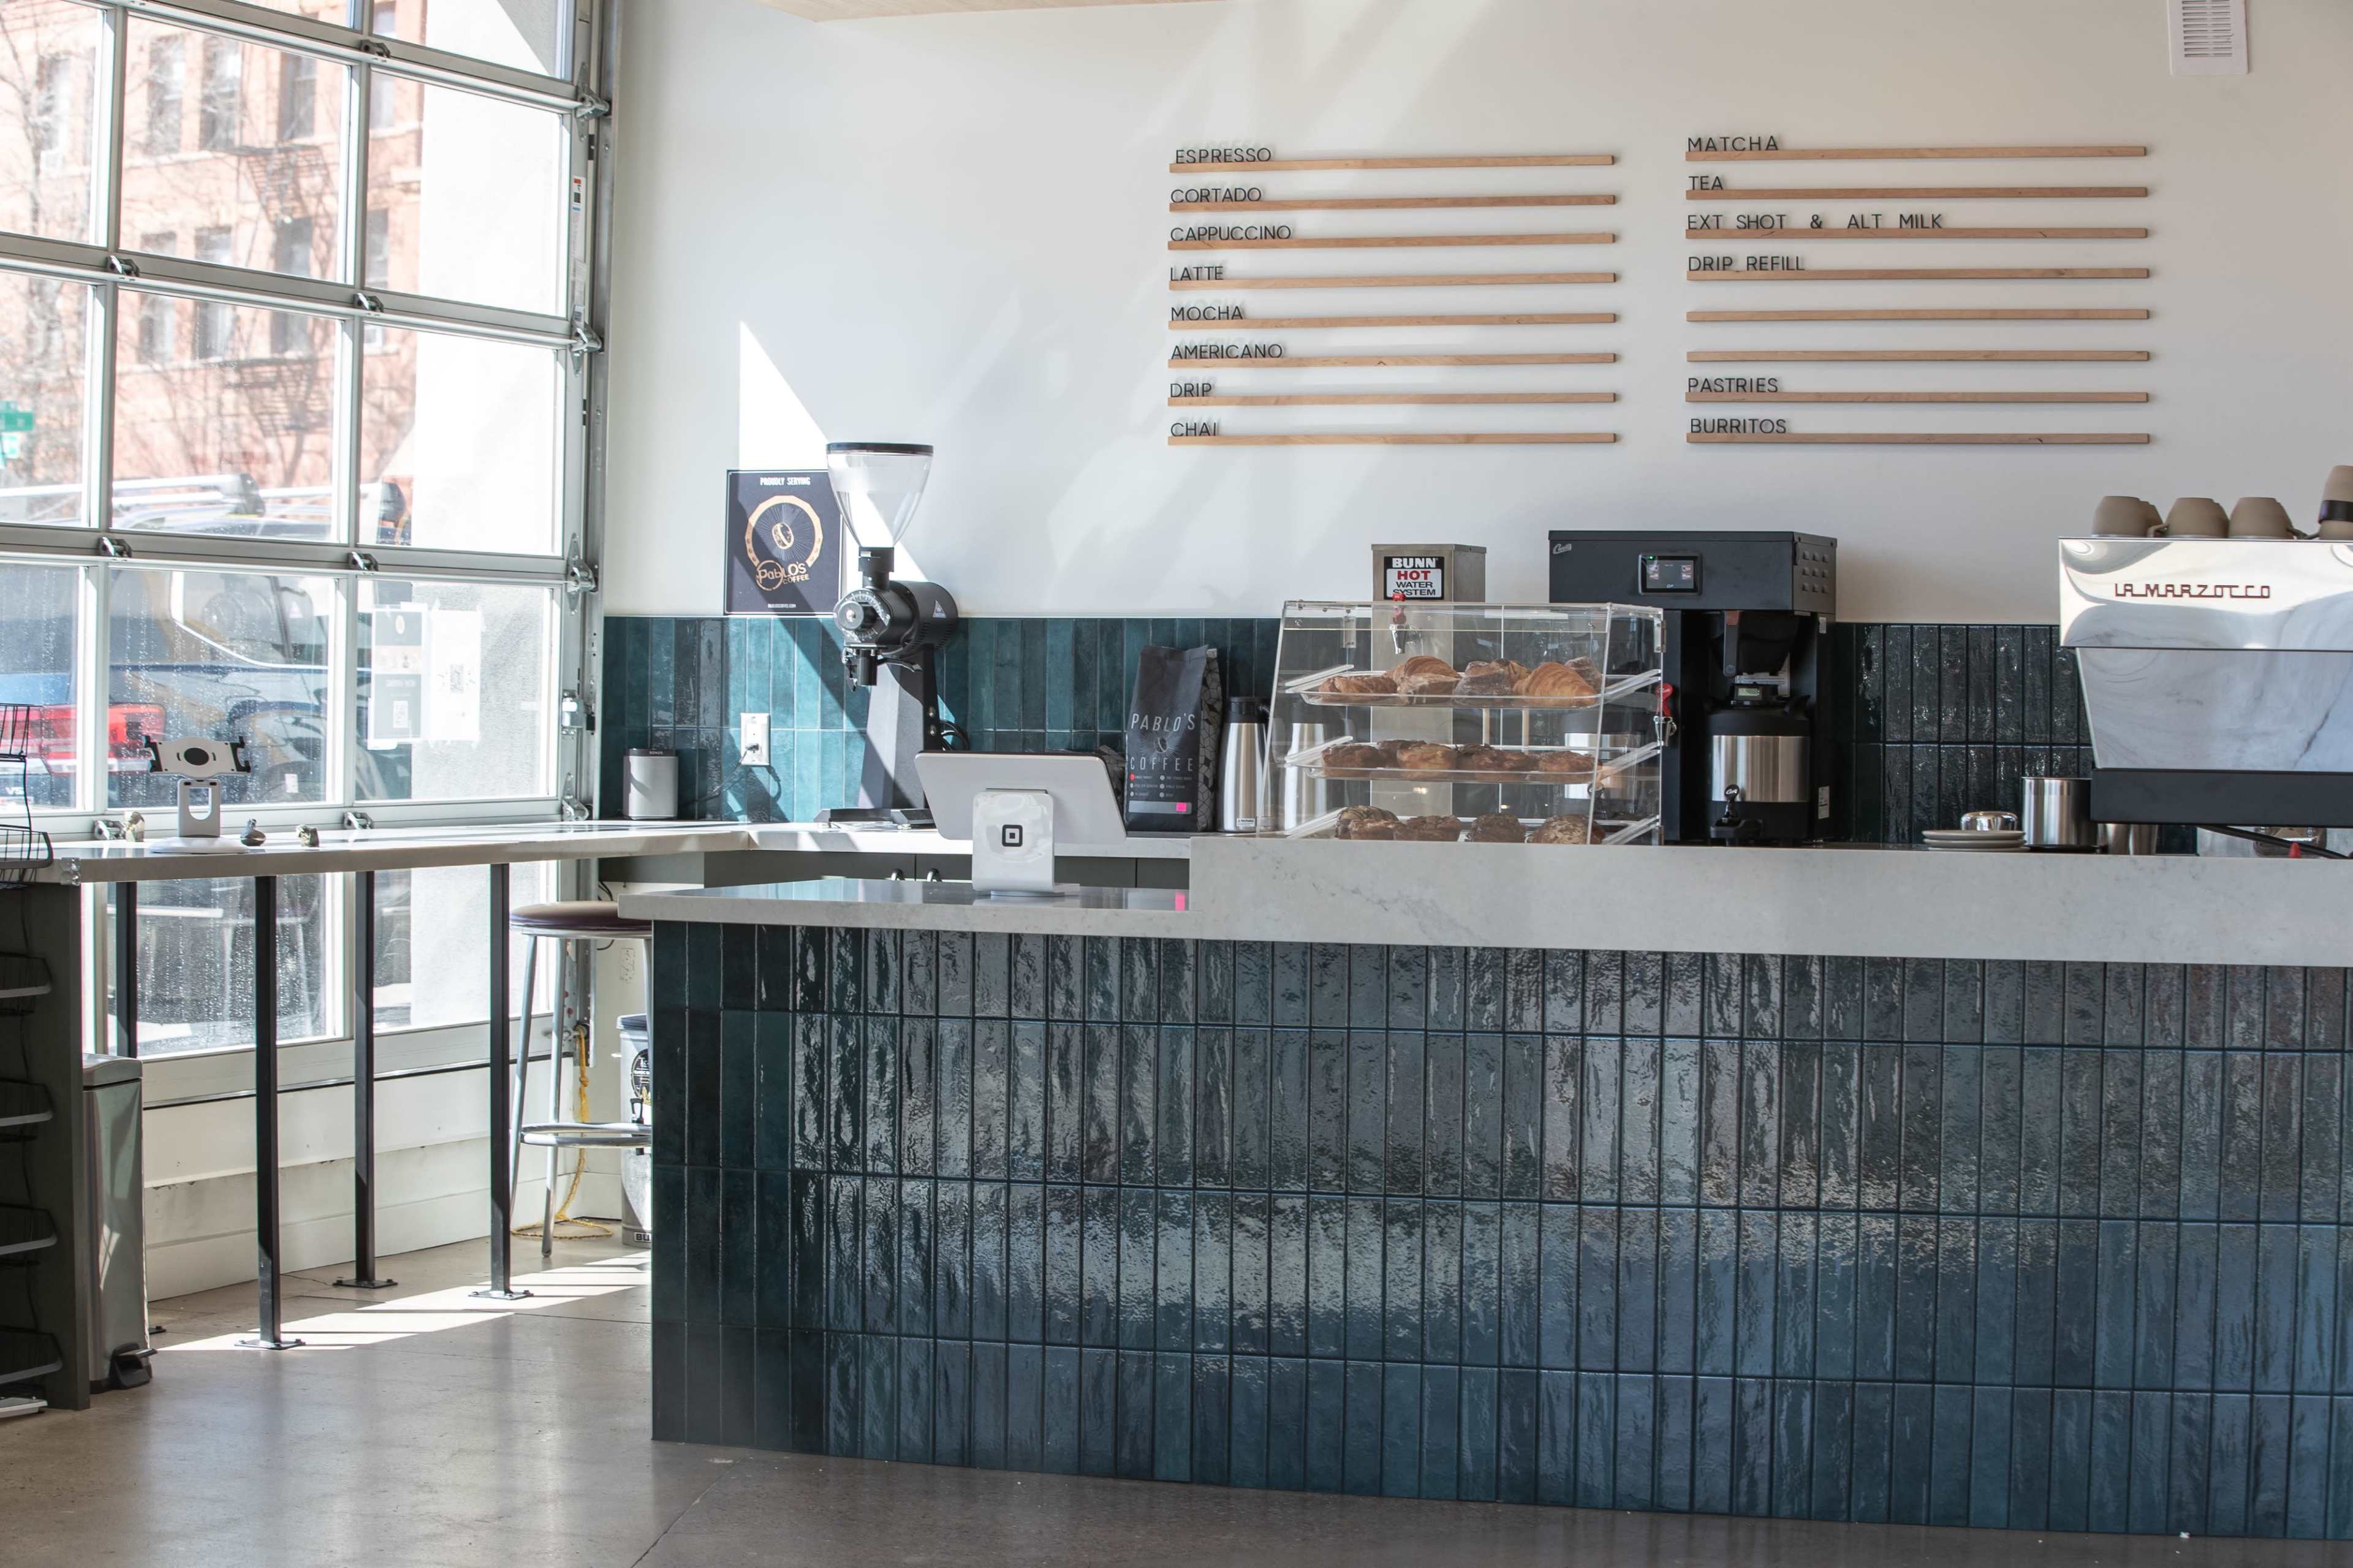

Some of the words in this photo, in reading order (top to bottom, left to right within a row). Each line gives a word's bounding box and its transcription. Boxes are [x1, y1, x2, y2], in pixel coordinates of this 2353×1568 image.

[1688, 135, 1779, 152] MATCHA
[1175, 148, 1271, 164] ESPRESSO
[1689, 176, 1724, 191] TEA
[1170, 187, 1262, 203] CORTADO
[1688, 214, 1723, 230] EXT
[1736, 214, 1787, 230] SHOT
[1809, 214, 1824, 230] &
[1847, 214, 1882, 230] ALT
[1899, 214, 1943, 229] MILK
[1170, 225, 1292, 241] CAPPUCCINO
[1688, 256, 1733, 271] DRIP
[1746, 256, 1805, 271] REFILL
[1170, 266, 1224, 281] LATTE
[1171, 306, 1243, 321] MOCHA
[1170, 343, 1283, 360] AMERICANO
[1170, 383, 1213, 398] DRIP
[1688, 377, 1779, 393] PASTRIES
[1170, 422, 1217, 437] CHAI
[1690, 419, 1787, 434] BURRITOS
[760, 476, 785, 486] PROUDLY
[787, 476, 811, 486] SERVING
[1392, 558, 1436, 569] BUNN
[782, 574, 810, 584] COFFEE
[1397, 570, 1431, 580] HOT
[2115, 583, 2134, 597] LA
[2146, 583, 2270, 599] MARZOCCO
[1131, 713, 1195, 732] PABLO'S
[1130, 757, 1193, 771] COFFEE
